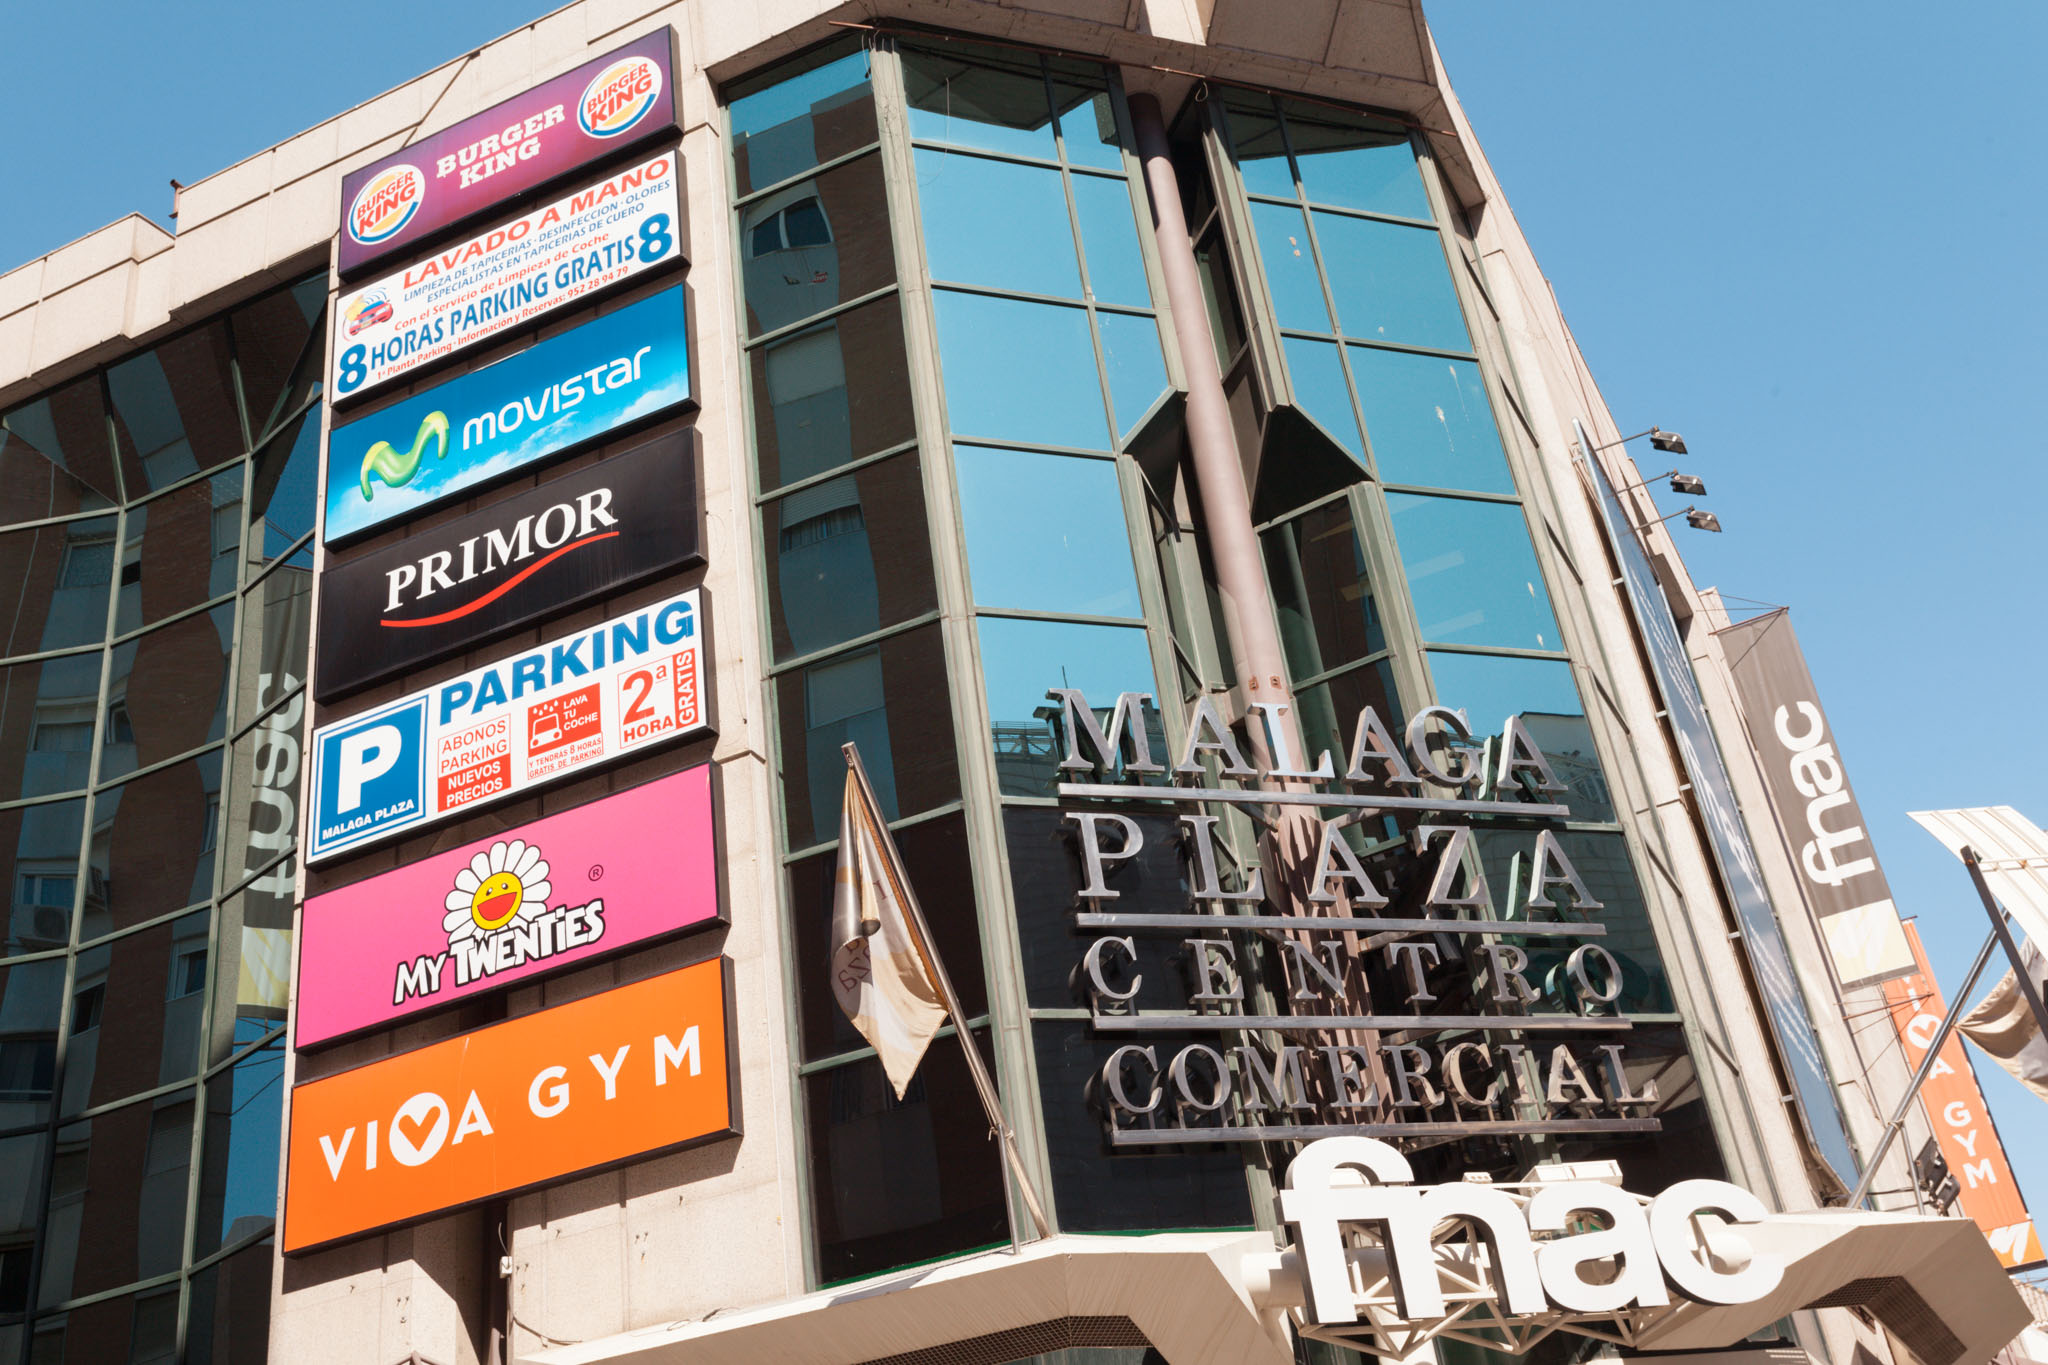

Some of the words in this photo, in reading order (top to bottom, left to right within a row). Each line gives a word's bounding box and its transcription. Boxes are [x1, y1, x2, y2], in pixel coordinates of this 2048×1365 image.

[587, 63, 649, 114] BURGER
[590, 73, 652, 132] KING
[436, 104, 565, 178] BURGER
[459, 136, 541, 189] KING
[357, 171, 415, 218] BURGER
[358, 182, 416, 238] KING
[403, 220, 531, 290] LAVADO
[538, 207, 561, 231] A
[570, 159, 670, 216] MANO
[404, 276, 452, 302] LIMPIEZA
[454, 268, 469, 280] DE
[471, 239, 532, 272] TAPICERIAS
[539, 201, 619, 242] DESINFECCION
[625, 179, 670, 205] OLORES
[427, 261, 504, 303] ESPECIALISTAS
[506, 256, 521, 268] EN
[524, 226, 586, 261] TAPICERIAS
[588, 221, 603, 232] DE
[606, 202, 645, 224] CUERO
[337, 343, 368, 394] 8
[371, 317, 444, 370] HORAS
[450, 271, 548, 336] PARKING
[555, 234, 635, 289] GRATIS
[638, 212, 673, 264] 8
[394, 317, 417, 331] Con
[420, 308, 430, 321] el
[433, 290, 478, 315] Servicio
[481, 283, 495, 294] de
[498, 257, 551, 286] Limpieza
[553, 249, 569, 262] de
[572, 232, 609, 254] Coche
[387, 358, 416, 376] Planta
[417, 343, 452, 363] Parking
[515, 314, 521, 324] y
[522, 294, 567, 318] Reservas:
[567, 284, 586, 299] 952
[588, 278, 600, 291] 28
[602, 271, 614, 283] 94
[617, 265, 629, 278] 79
[462, 346, 651, 451] movistar
[383, 487, 619, 613] PRIMOR
[439, 600, 695, 726] PARKING
[676, 650, 696, 725] GRATIS
[441, 719, 507, 755] ABONOS
[563, 694, 588, 710] LAVA
[563, 708, 577, 720] TU
[563, 711, 599, 731] COCHE
[623, 715, 674, 743] HORA
[337, 724, 402, 815] P
[441, 739, 508, 773] PARKING
[448, 760, 501, 791] NUEVOS
[529, 763, 555, 778] GRATIS
[558, 758, 567, 768] DE
[570, 746, 602, 764] PARKING
[536, 749, 568, 766] TENDRAS
[569, 744, 576, 754] 8
[577, 737, 602, 752] HORAS
[1045, 686, 1569, 793] MALAGA
[322, 814, 372, 841] MALAGA
[375, 799, 415, 822] PLAZA
[446, 777, 503, 808] PRECIOS
[1774, 700, 1876, 887] fnac
[1065, 811, 1605, 911] PLAZA
[393, 952, 447, 1005] MY
[1082, 935, 1624, 1007] CENTRO
[528, 1025, 702, 1119] GYM
[1101, 1042, 1662, 1114] COMERCIAL
[1943, 1101, 1998, 1189] GYM
[1279, 1136, 1785, 1325] fnac
